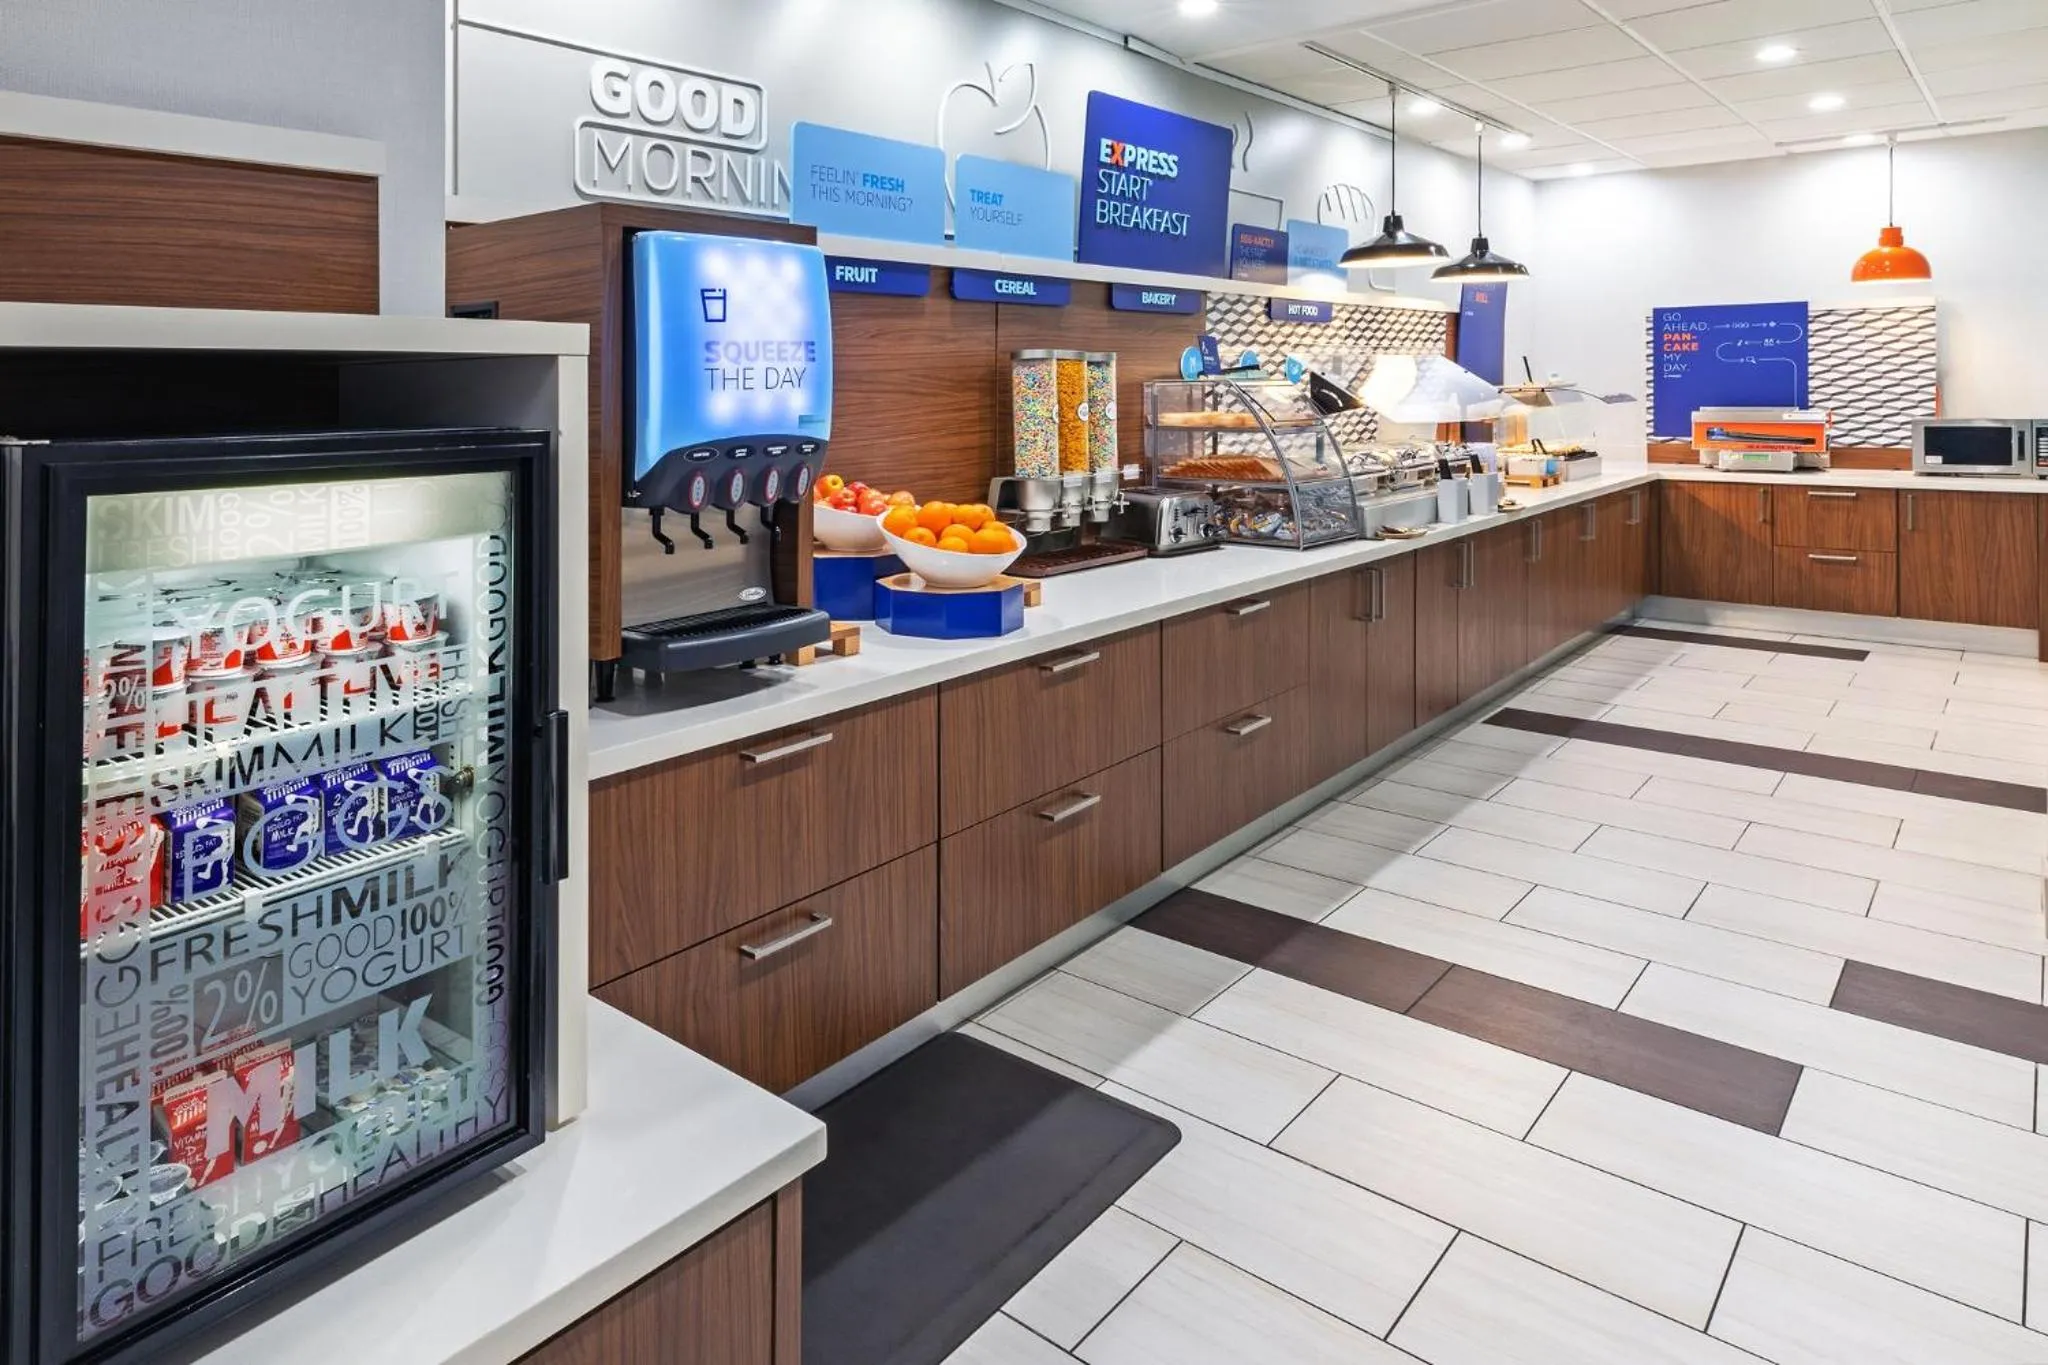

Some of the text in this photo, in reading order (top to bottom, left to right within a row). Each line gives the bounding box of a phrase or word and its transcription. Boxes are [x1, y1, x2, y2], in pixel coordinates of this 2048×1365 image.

[590, 59, 758, 139] GOOD
[1100, 138, 1178, 178] EXPRESS
[811, 184, 913, 212] THIS MORNING?
[862, 173, 904, 192] FRESH
[969, 188, 1004, 205] TREAT
[970, 206, 1023, 226] YOURSELF
[1096, 199, 1190, 236] BREAKFAST
[835, 265, 878, 283] FRUIT
[994, 279, 1037, 296] CEREAL
[1141, 291, 1177, 306] BAKERY
[1288, 304, 1319, 317] HOT FOOD
[1663, 312, 1681, 321] GO
[704, 341, 816, 363] SQUEEZE
[1664, 333, 1697, 341] PAN-
[1664, 342, 1699, 351] CAKE
[1664, 353, 1681, 361] MY
[705, 367, 807, 391] THE DAY
[100, 496, 217, 542] SKIM
[219, 492, 241, 560] GOOD
[299, 485, 328, 552] MILK
[477, 534, 506, 640] GOOD
[170, 570, 457, 661] YOGURT
[477, 639, 506, 766] MILK
[151, 745, 266, 808] SKIM
[183, 763, 453, 908] EGGS
[150, 845, 472, 985] FRESH MILK
[288, 886, 469, 979] GOOD 100%
[291, 924, 467, 1016] YOGURT
[202, 960, 278, 1046] 2%
[206, 993, 434, 1158] MILK
[318, 1083, 506, 1216] HEALTHY
[89, 1211, 268, 1328] GOOD
